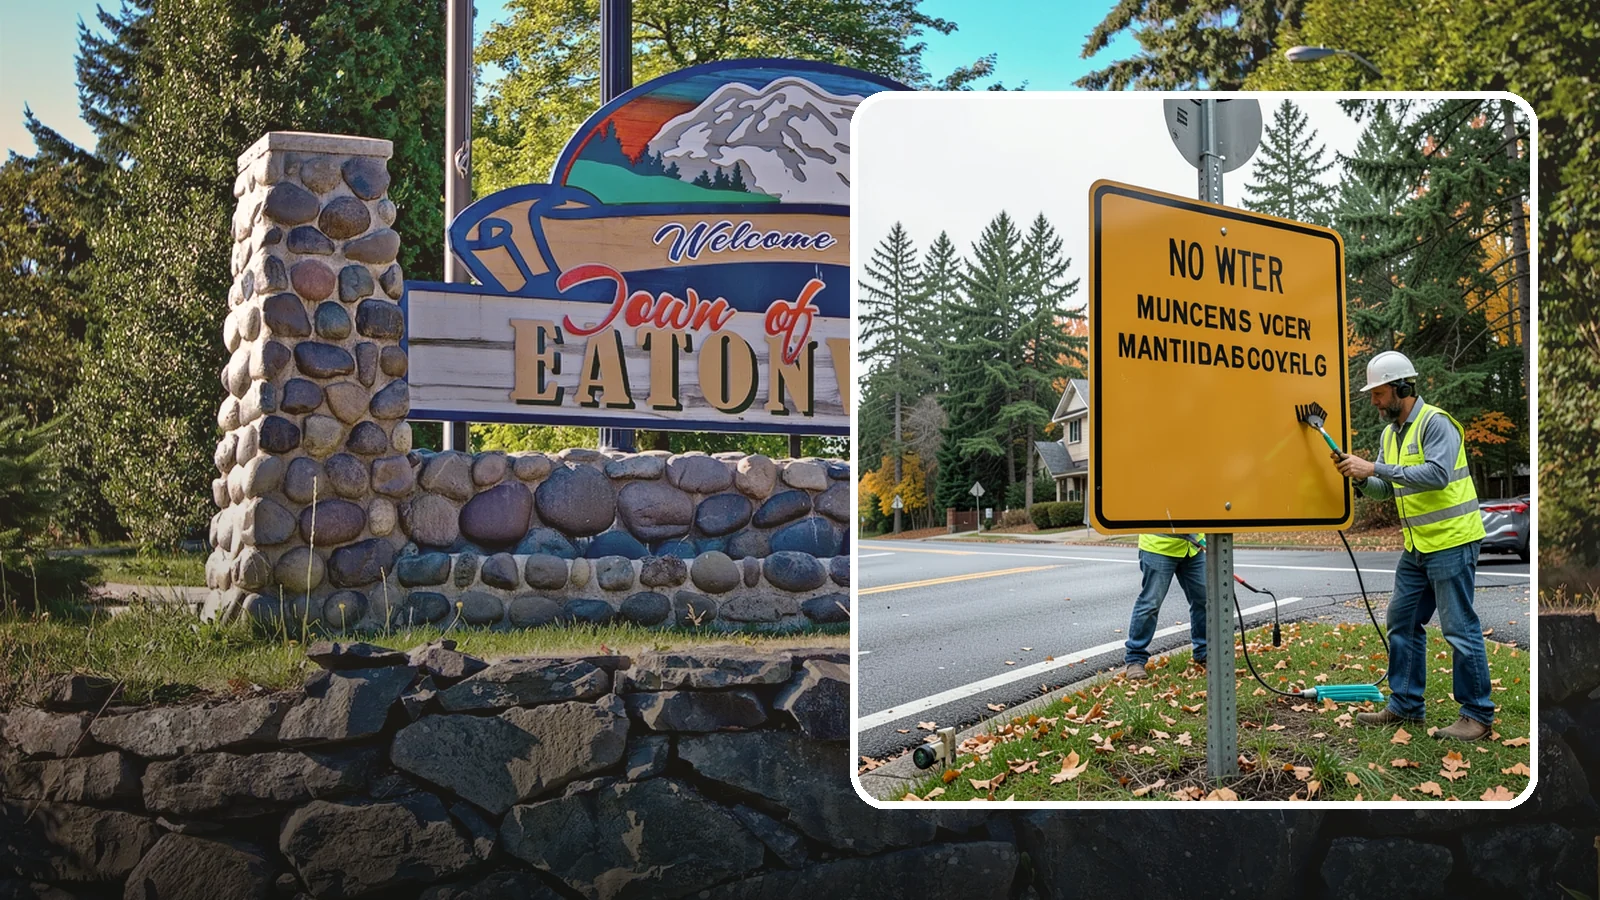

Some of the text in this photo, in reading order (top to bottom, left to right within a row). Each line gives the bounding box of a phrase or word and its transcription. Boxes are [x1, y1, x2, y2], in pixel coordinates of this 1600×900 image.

[653, 221, 838, 263] Welcome
[1169, 238, 1284, 294] NO WTER
[557, 263, 826, 366] Town of
[1137, 294, 1252, 333] MUNCENS
